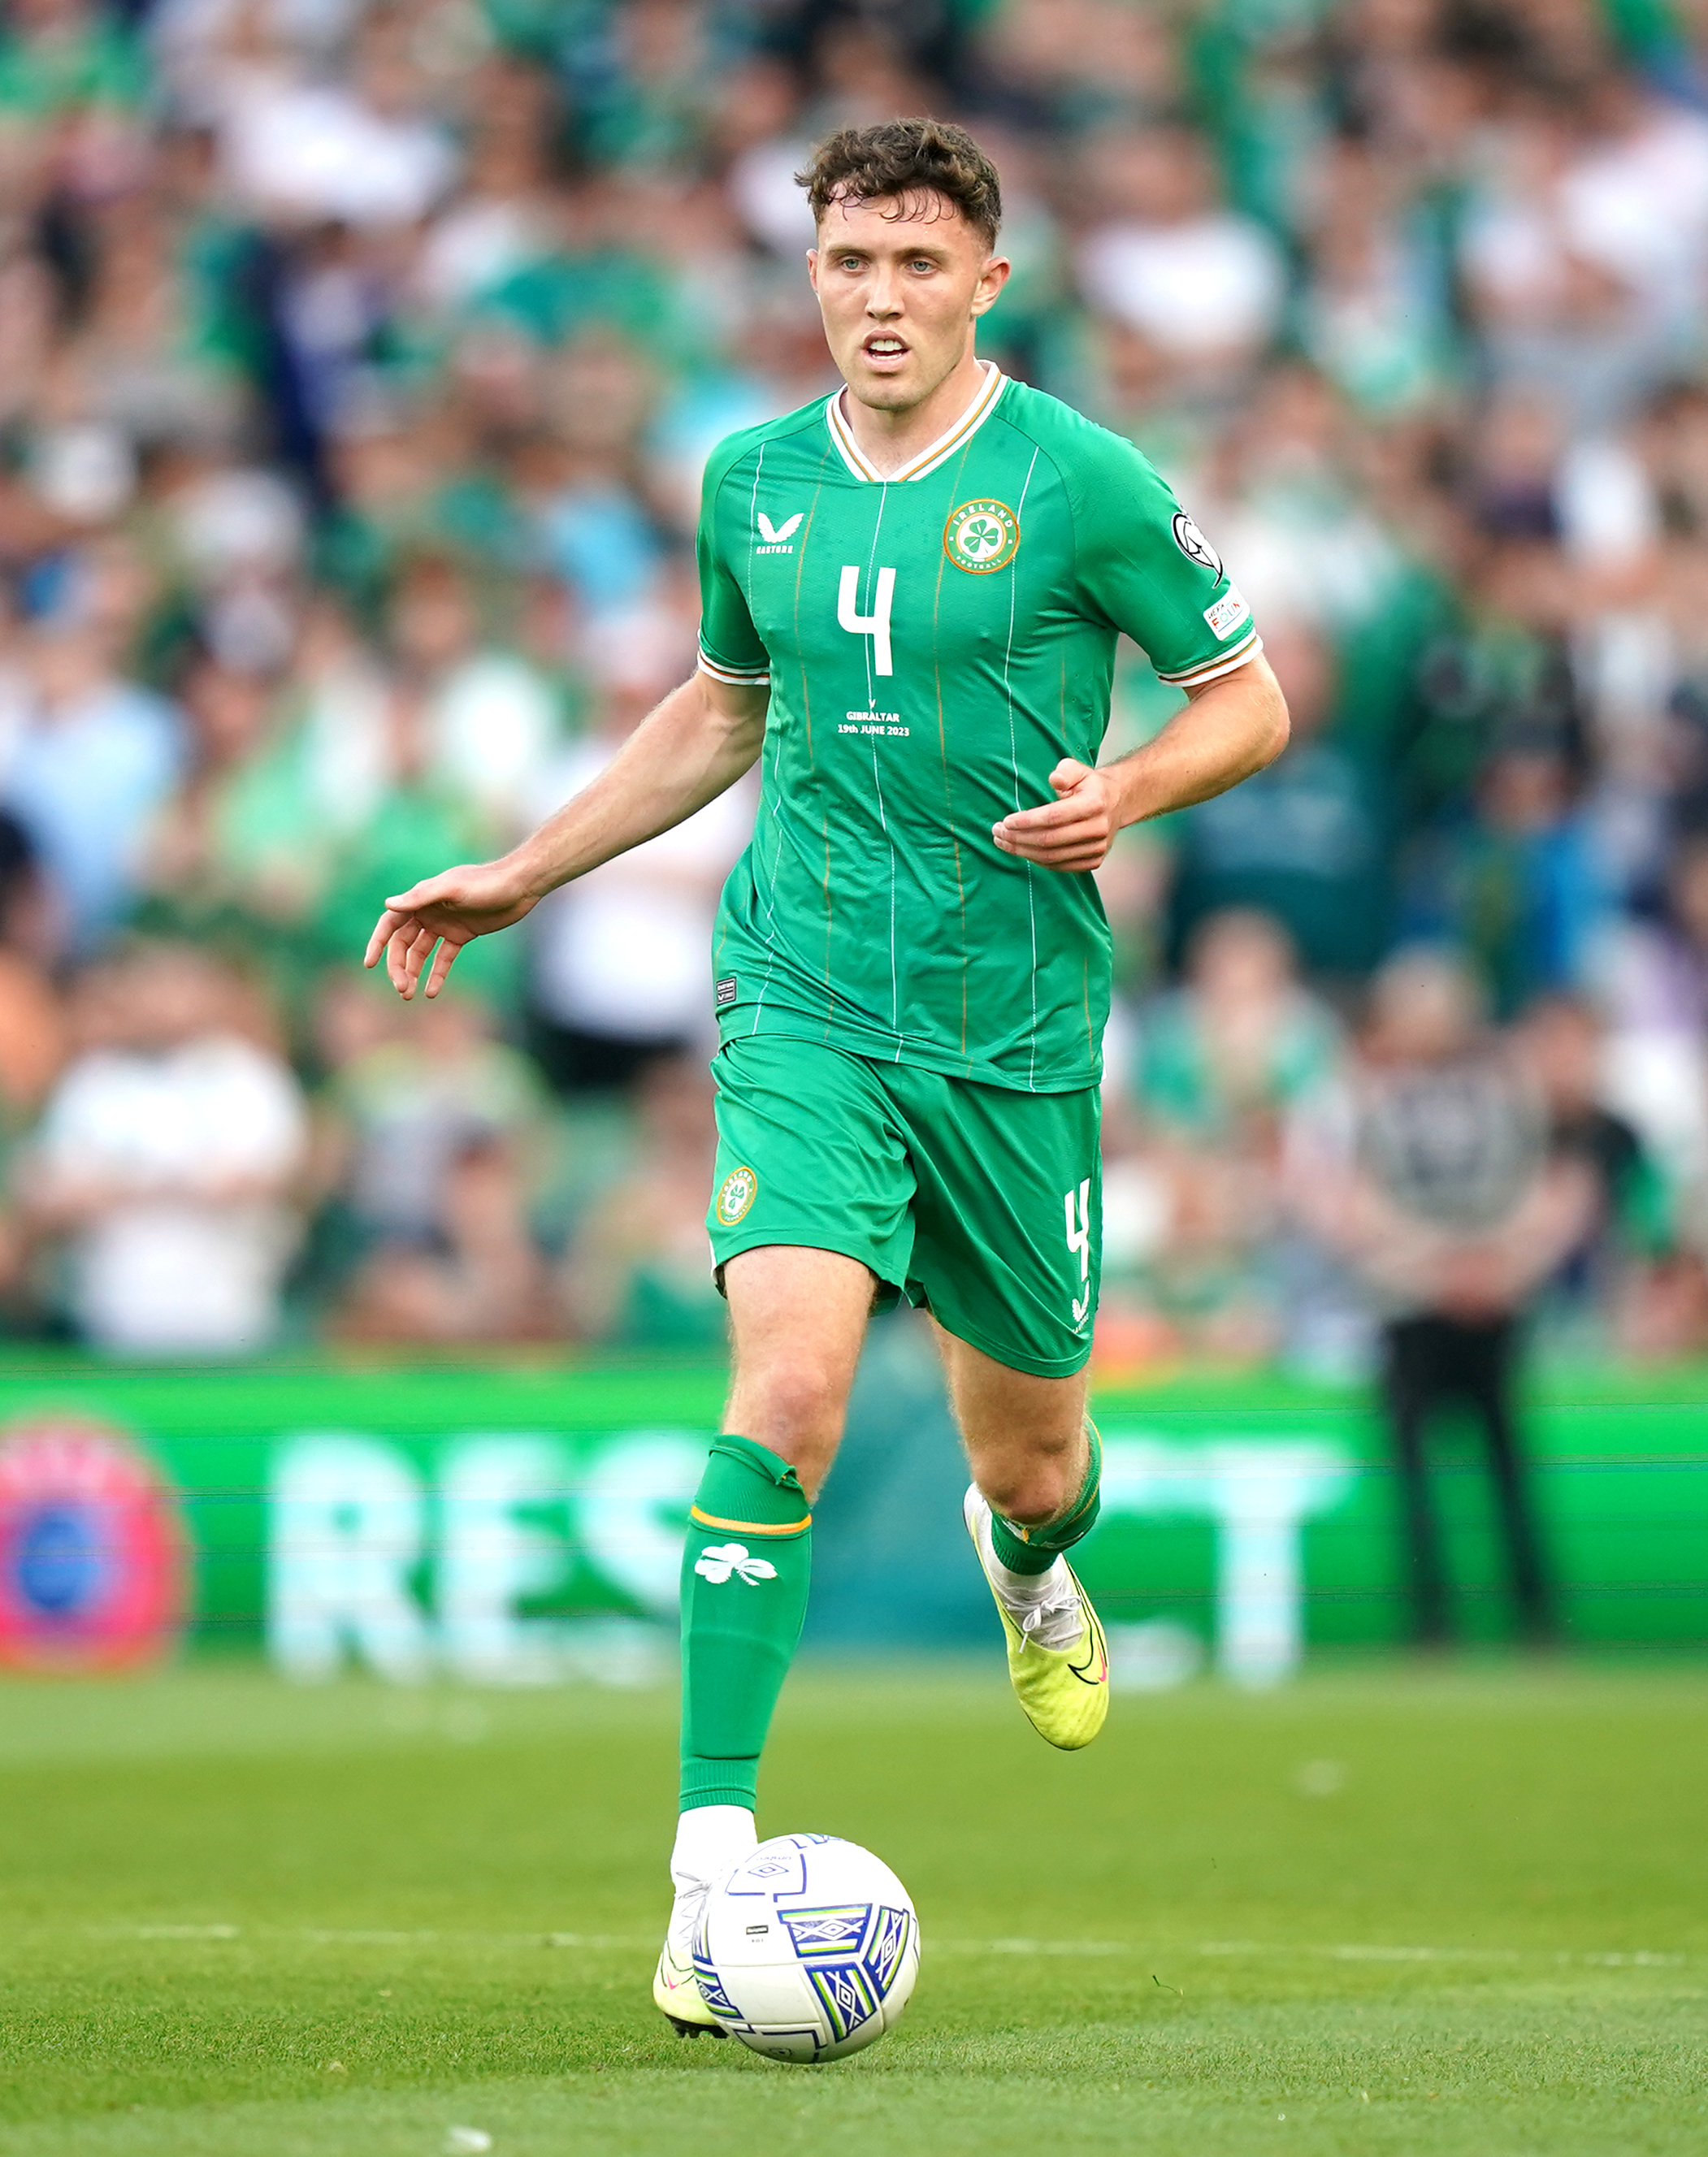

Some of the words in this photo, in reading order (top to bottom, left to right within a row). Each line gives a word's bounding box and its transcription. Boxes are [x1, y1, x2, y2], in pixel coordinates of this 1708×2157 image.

[952, 503, 1013, 527] IRELAND
[756, 545, 794, 554] CASTORE
[956, 555, 1002, 570] FOOTBALL
[1207, 604, 1225, 619] UEFA
[837, 565, 896, 676] 4
[846, 711, 900, 722] GIBRALTAR
[838, 724, 859, 734] 19th
[861, 725, 886, 735] JUNE
[887, 725, 909, 737] 2023
[1064, 1178, 1090, 1282] 4
